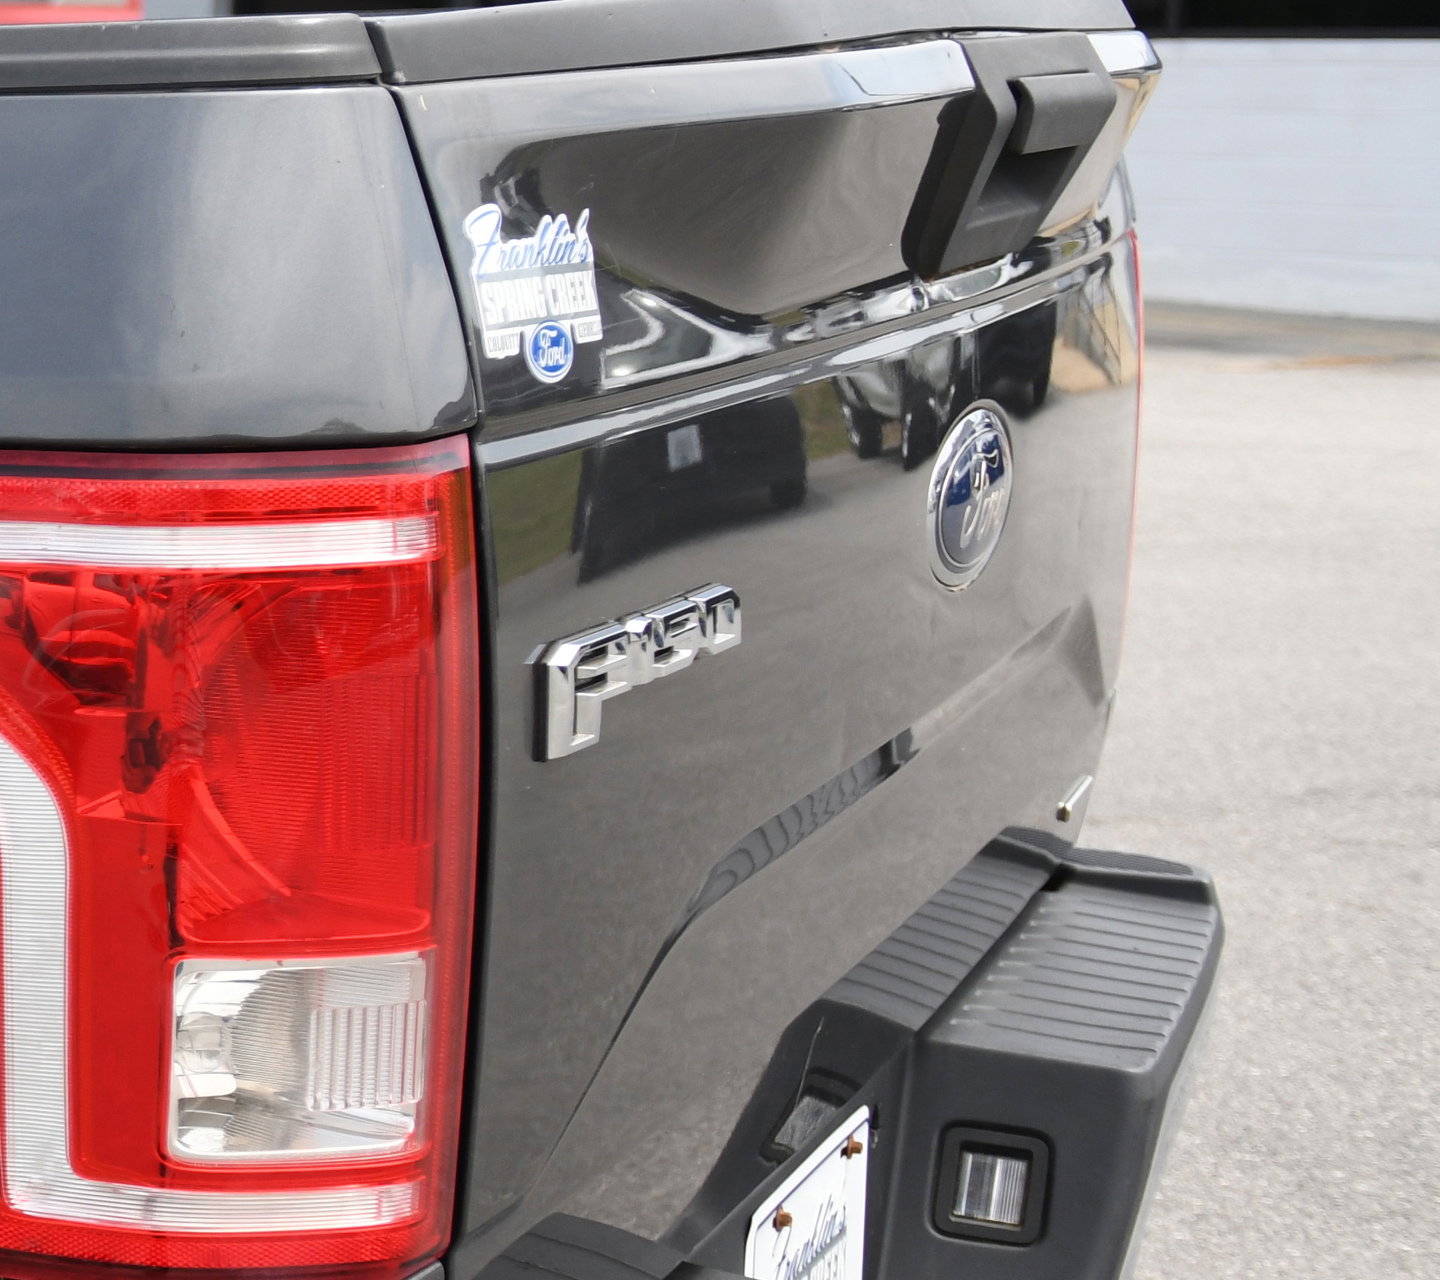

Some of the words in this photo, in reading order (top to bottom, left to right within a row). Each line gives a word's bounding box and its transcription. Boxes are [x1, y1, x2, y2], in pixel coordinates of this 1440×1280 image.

[468, 208, 590, 280] Franklin's
[481, 275, 548, 326] SPRING
[545, 269, 598, 317] CREEK
[538, 328, 568, 368] Ford
